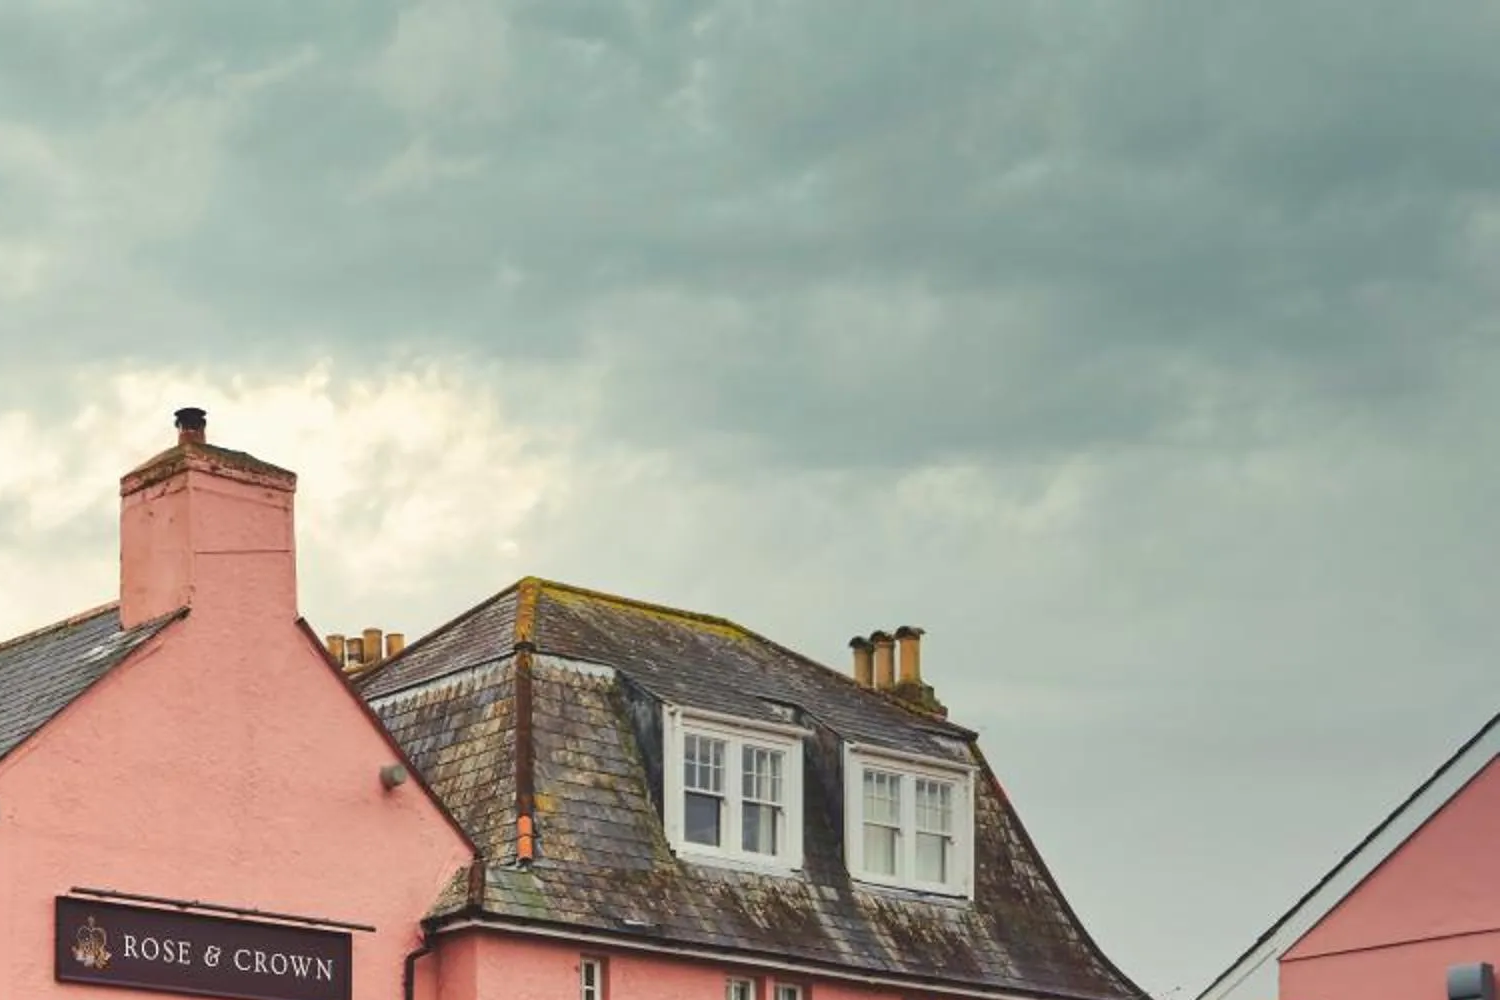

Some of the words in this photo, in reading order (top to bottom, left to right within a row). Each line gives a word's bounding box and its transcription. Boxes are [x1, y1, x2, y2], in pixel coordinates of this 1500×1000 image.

[124, 935, 191, 965] ROSE
[204, 945, 220, 967] &
[234, 949, 333, 981] CROWN
